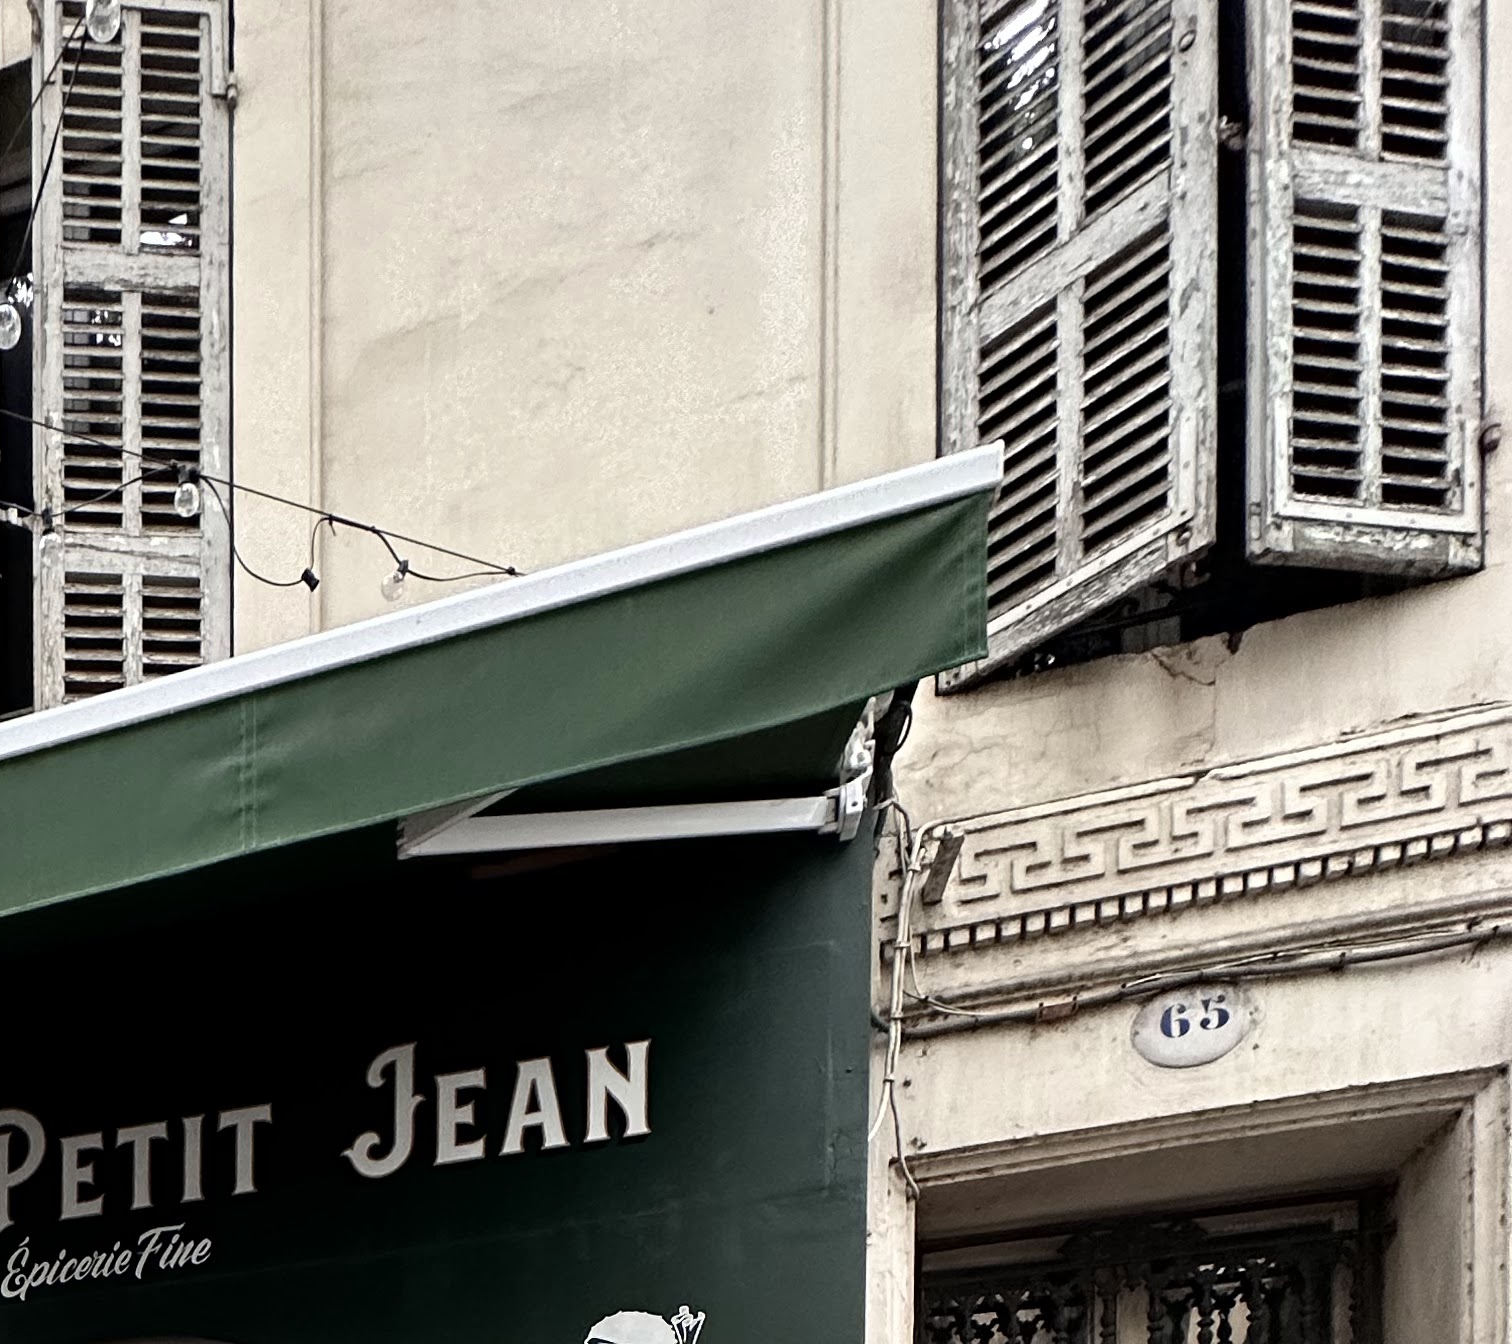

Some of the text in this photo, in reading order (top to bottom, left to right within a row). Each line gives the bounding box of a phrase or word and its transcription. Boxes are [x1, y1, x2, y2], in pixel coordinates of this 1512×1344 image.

[1160, 994, 1230, 1039] 65
[0, 1224, 211, 1300] Épicerie Fine
